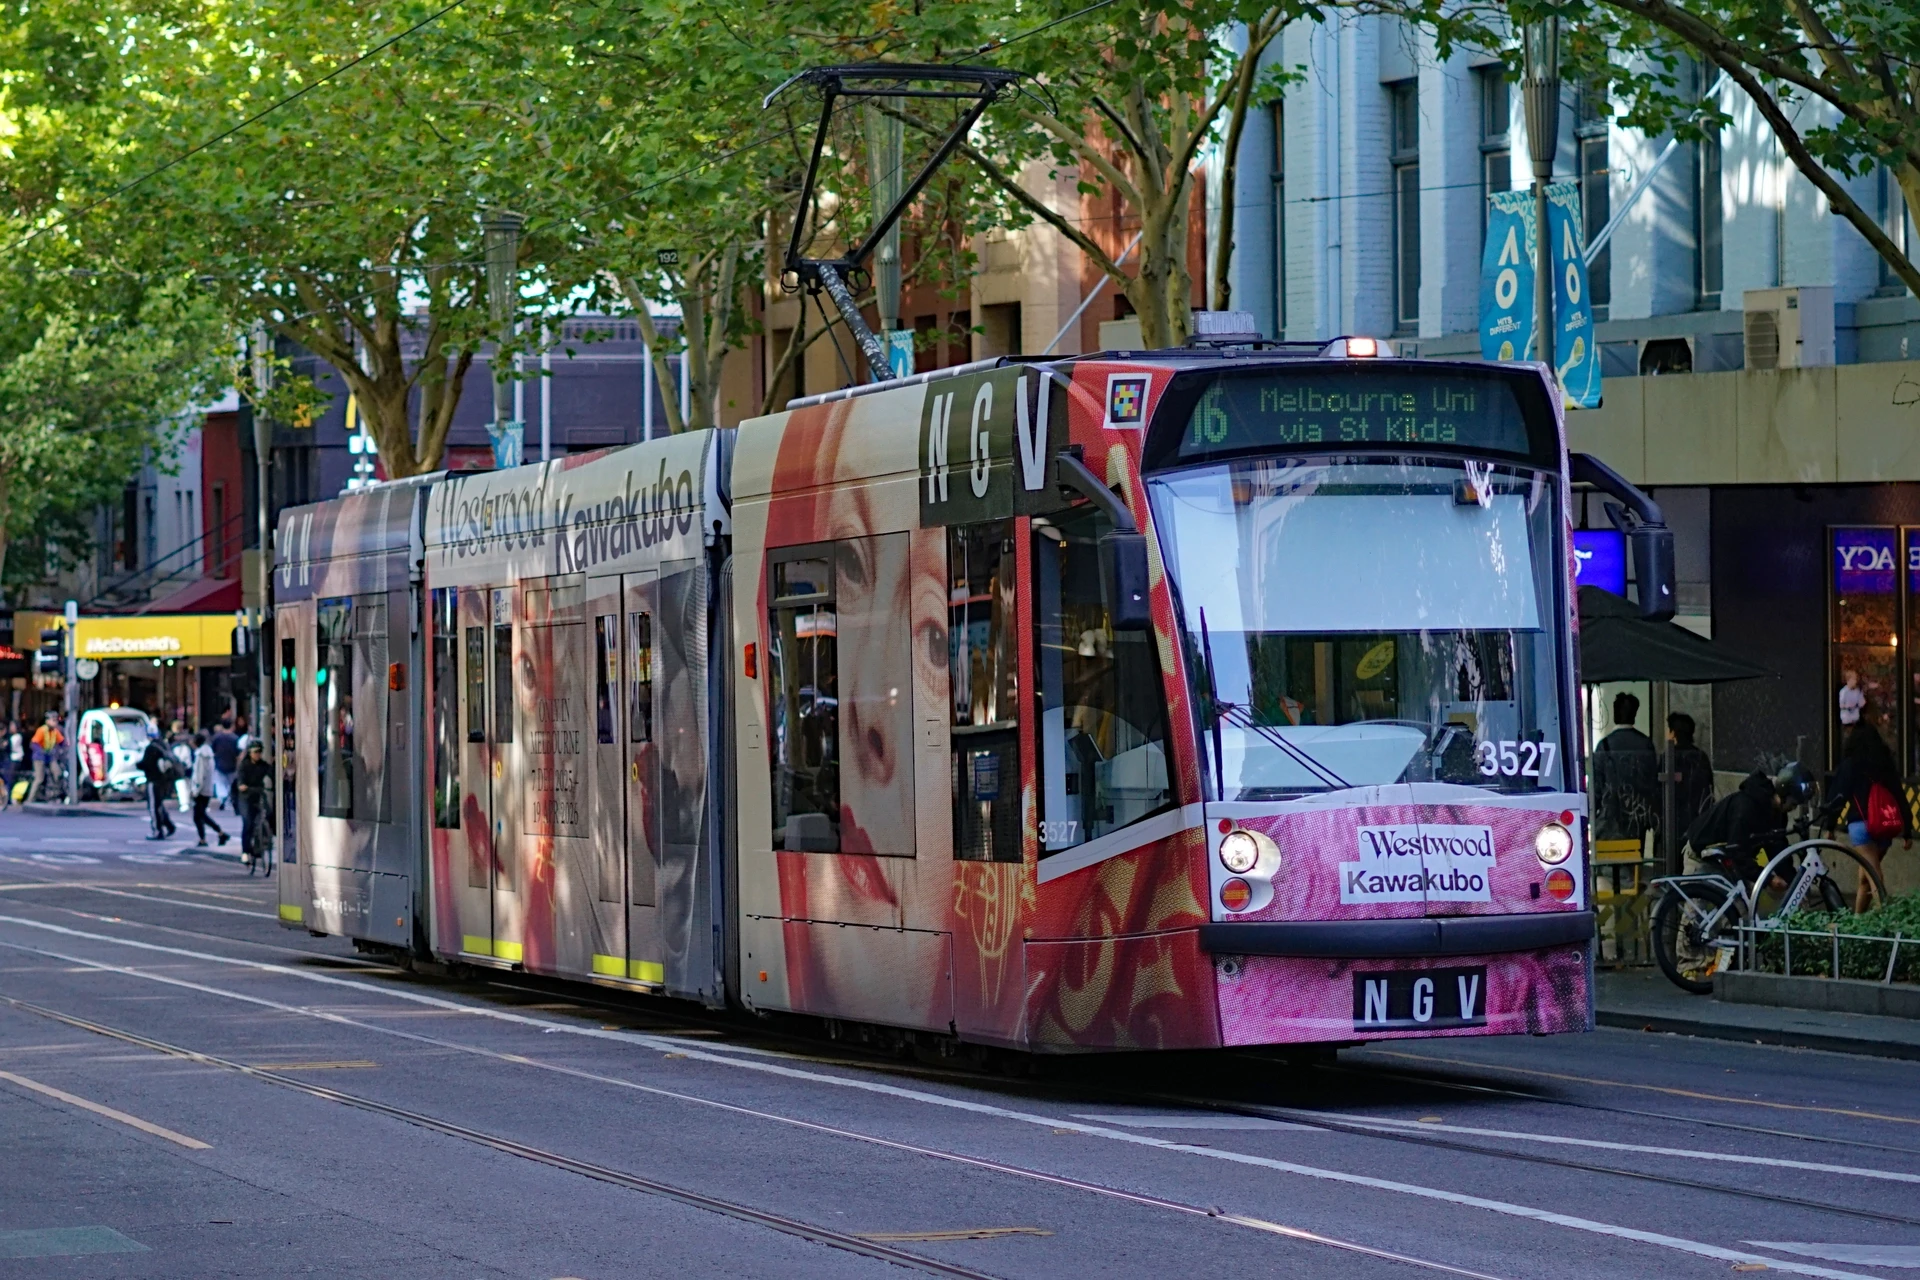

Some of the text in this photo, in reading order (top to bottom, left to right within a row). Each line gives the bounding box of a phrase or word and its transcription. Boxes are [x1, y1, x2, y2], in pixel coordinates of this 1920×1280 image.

[659, 252, 677, 263] 192
[1489, 321, 1522, 336] DIFFERENT
[1497, 316, 1513, 326] HITS
[1565, 316, 1588, 332] DIFFERENT
[1191, 386, 1476, 444] 16 Melbourne Uni
[1279, 416, 1457, 443] via St Kilda
[436, 457, 693, 575] Westwood Kawakubo
[85, 636, 181, 653] McDonald's
[538, 697, 571, 722] ONLY IN
[530, 730, 580, 755] MELBOURNE
[1477, 740, 1557, 777] 3527
[537, 767, 554, 792] DEC
[533, 800, 541, 823] 19
[560, 801, 580, 825] 2026
[1038, 820, 1078, 843] 3527
[1360, 830, 1493, 859] Westwood
[1347, 867, 1484, 894] Kawakubo
